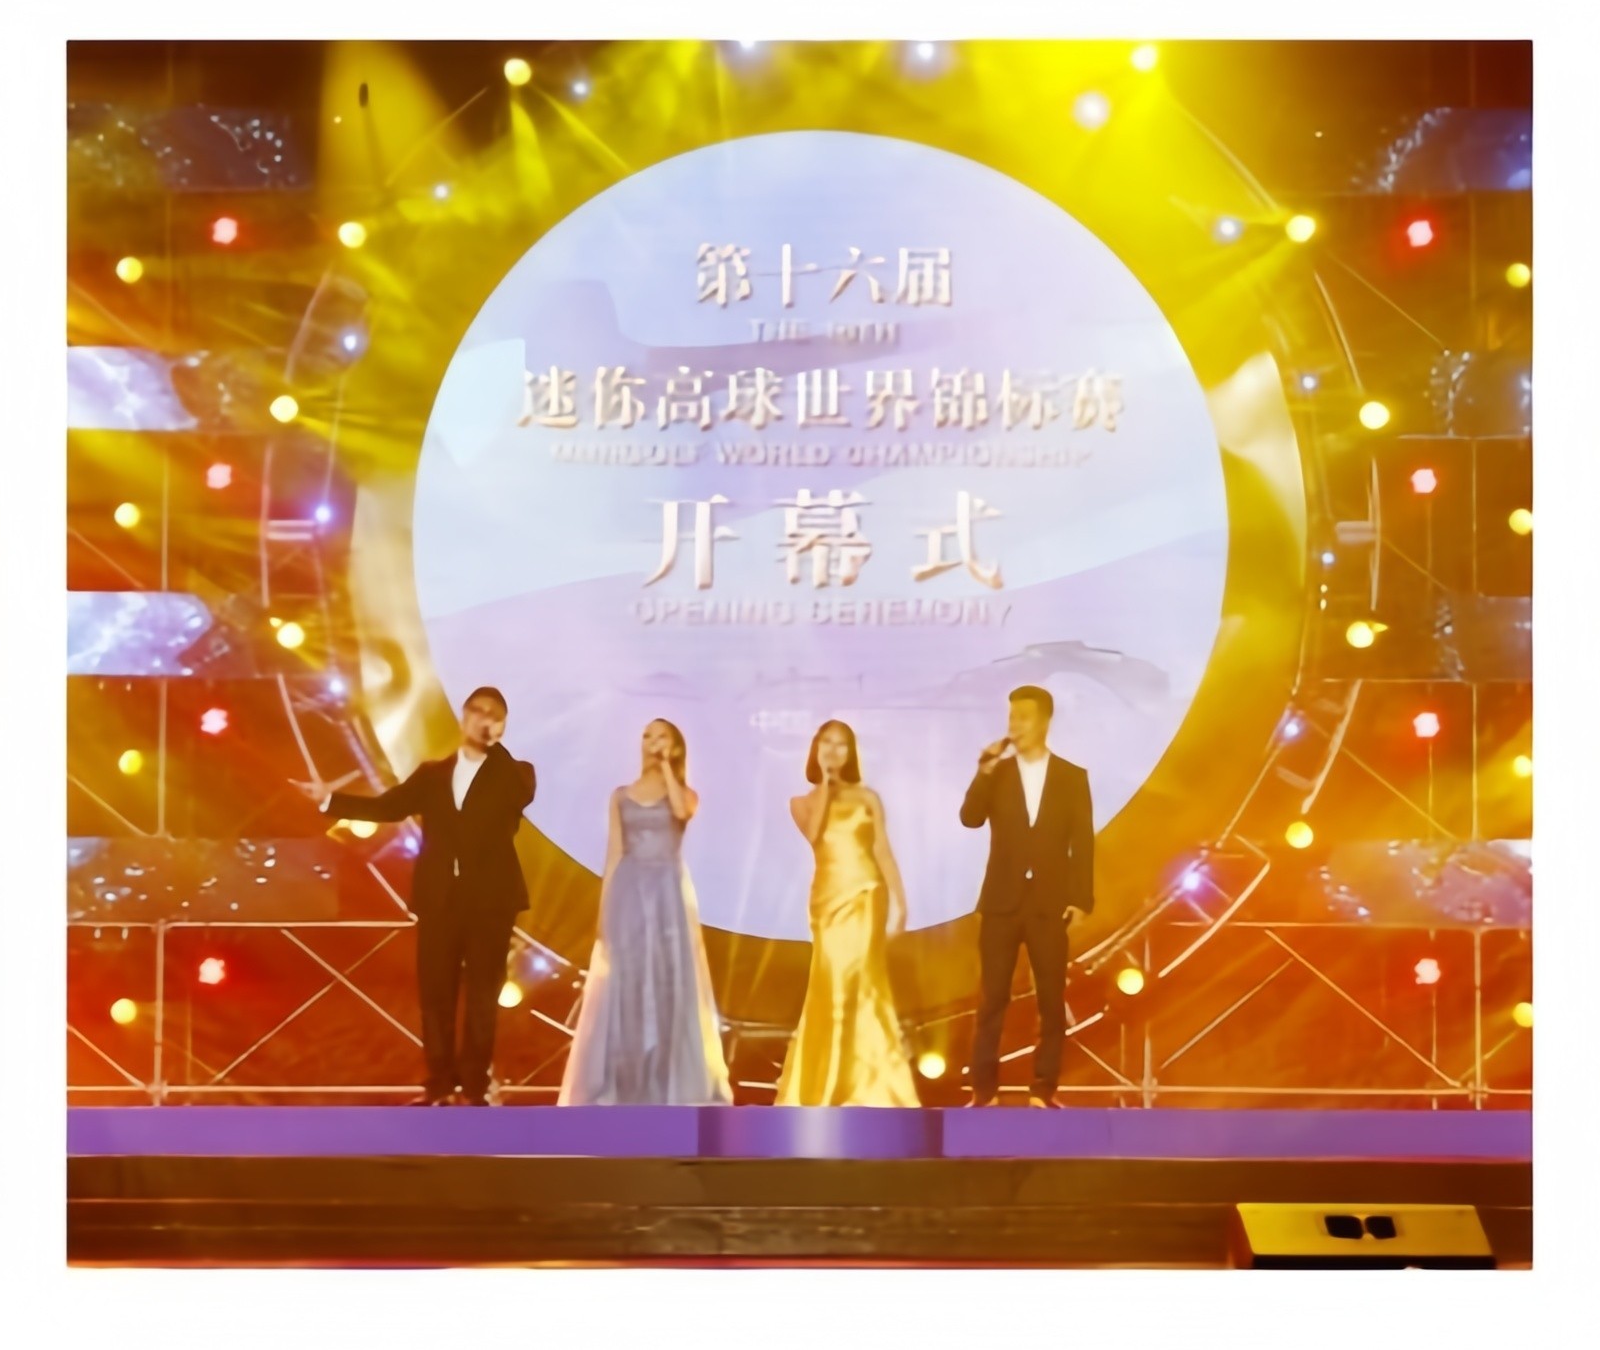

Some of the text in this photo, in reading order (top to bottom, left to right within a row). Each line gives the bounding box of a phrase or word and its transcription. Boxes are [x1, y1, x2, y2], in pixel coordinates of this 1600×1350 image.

[696, 243, 953, 308] 第十六届
[516, 365, 1126, 432] 迷你高球世界锦标赛
[715, 440, 831, 468] WORLD
[641, 488, 1005, 590] 开幕式
[630, 597, 1014, 629] OPENING CEREMONY
